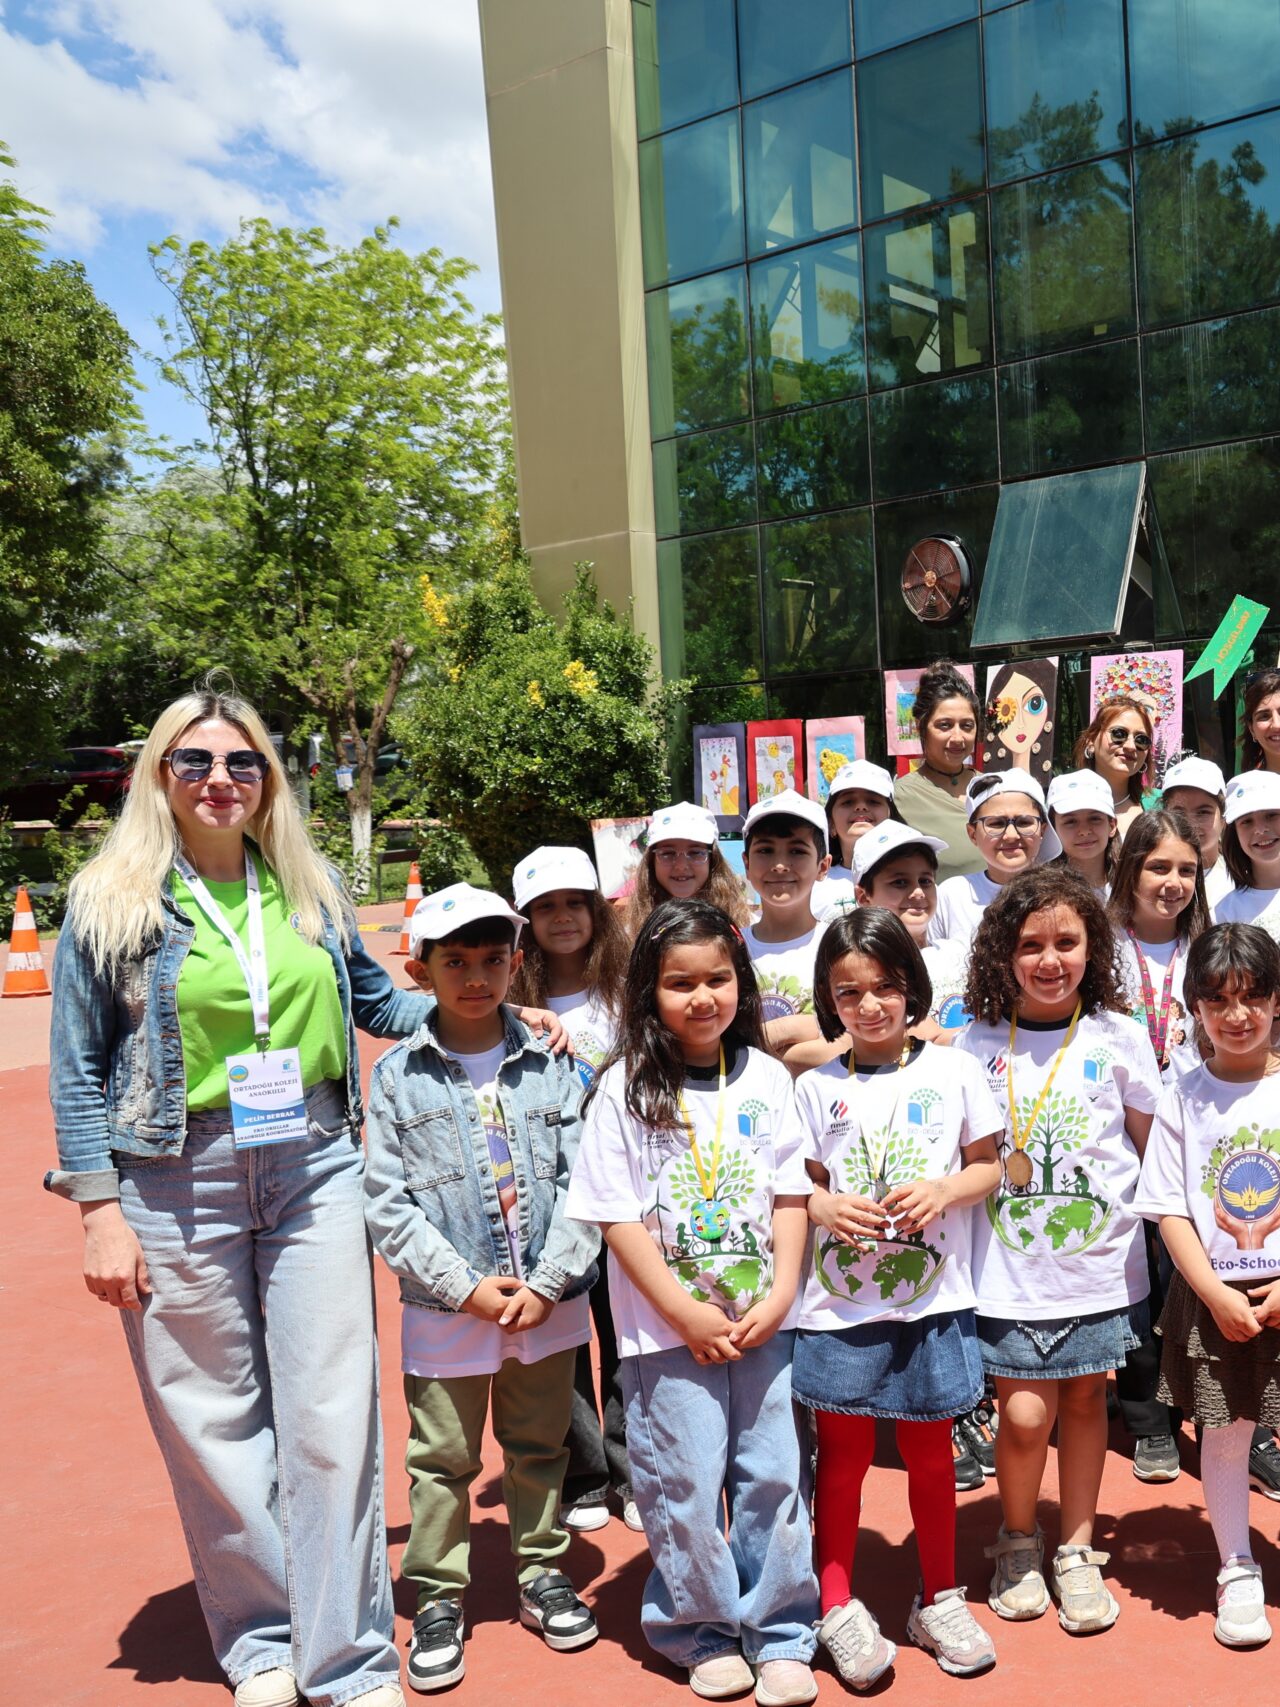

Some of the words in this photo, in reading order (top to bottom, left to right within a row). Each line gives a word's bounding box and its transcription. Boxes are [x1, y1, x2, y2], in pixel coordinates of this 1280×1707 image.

[233, 1081, 273, 1093] ORTADOĞU
[249, 1088, 287, 1098] ANAOKULU
[1222, 1154, 1257, 1185] ORTADOĞU
